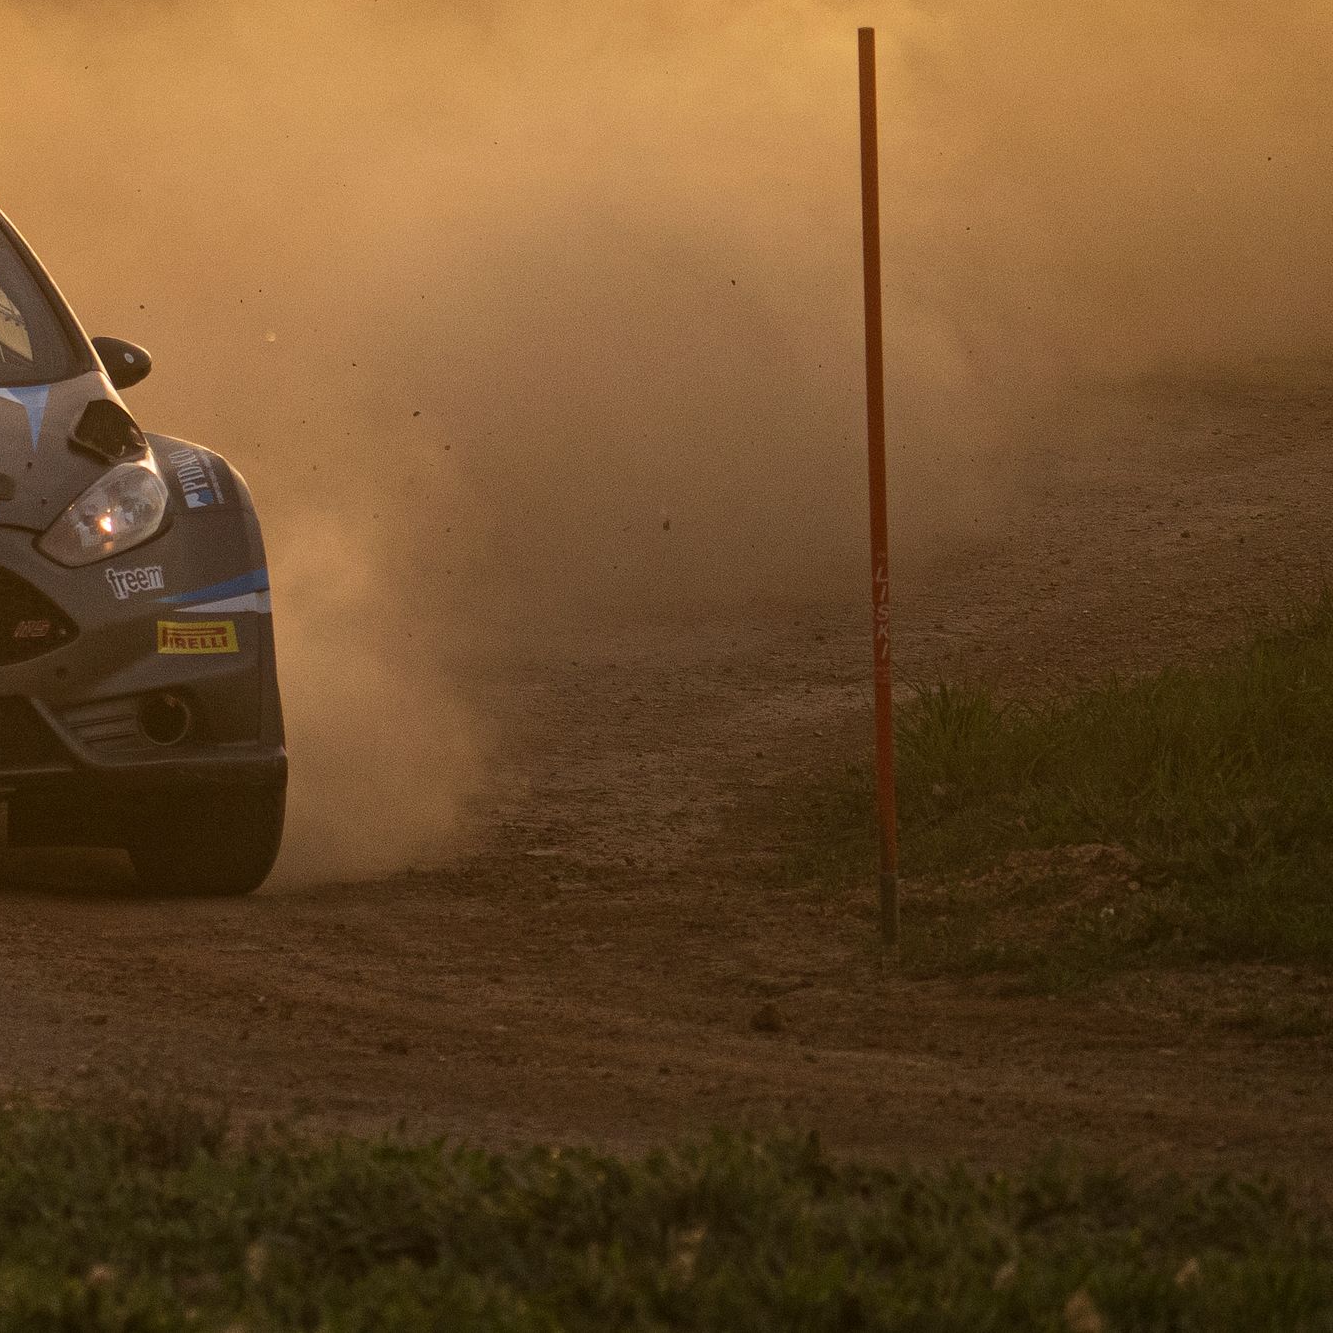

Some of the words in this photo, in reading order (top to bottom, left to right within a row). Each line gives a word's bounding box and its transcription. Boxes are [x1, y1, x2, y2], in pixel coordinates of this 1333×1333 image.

[106, 566, 165, 600] freem
[875, 566, 890, 660] LISKI
[161, 626, 228, 648] PIRELLI
